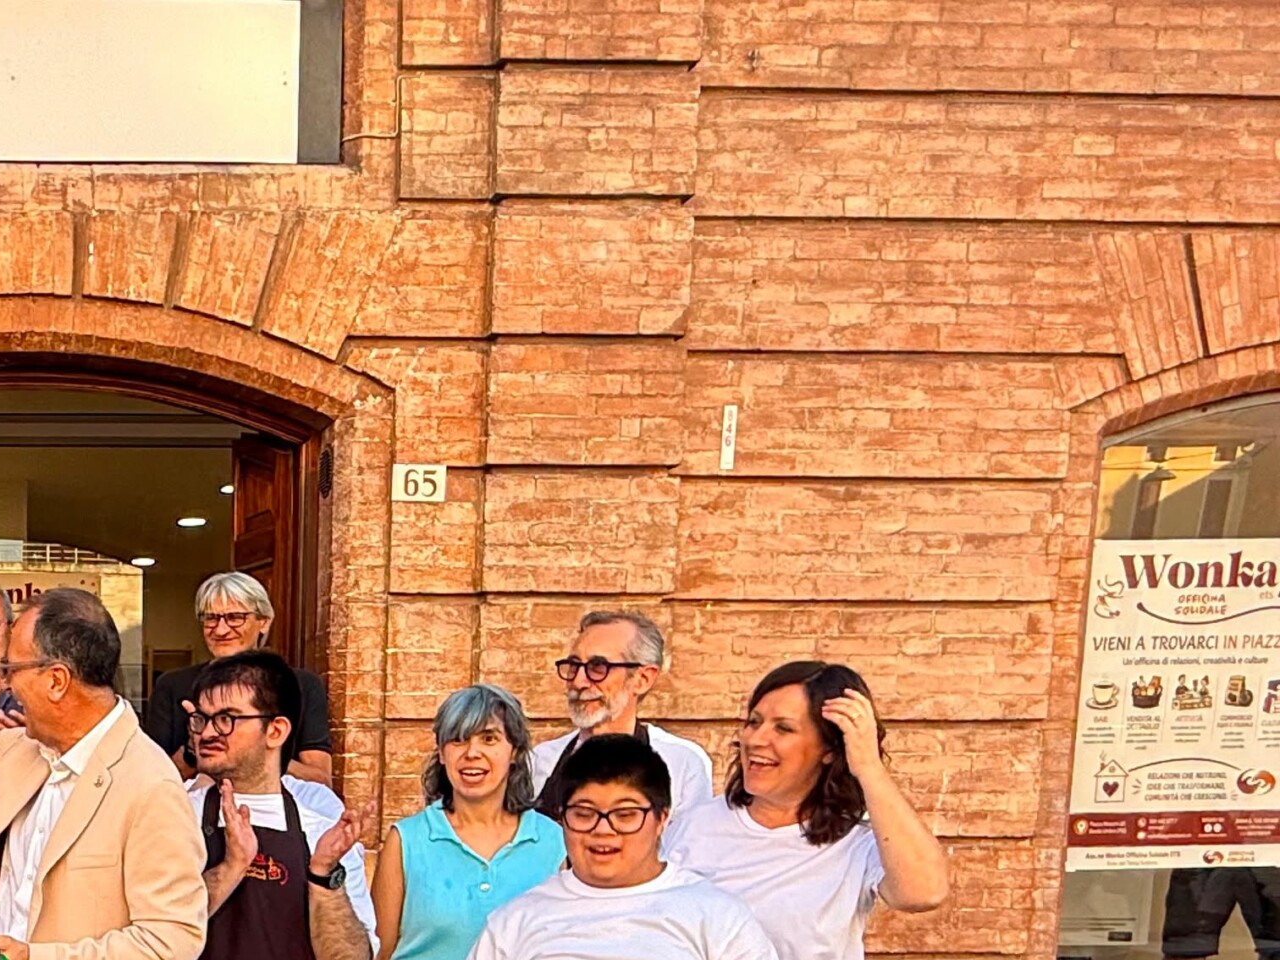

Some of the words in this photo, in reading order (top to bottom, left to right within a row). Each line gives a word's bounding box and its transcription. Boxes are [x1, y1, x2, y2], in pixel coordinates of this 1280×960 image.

[403, 469, 437, 497] 65
[1119, 550, 1279, 589] Wonka
[1178, 593, 1226, 604] OFFICINA
[1174, 605, 1228, 615] SOLIDALE
[1093, 636, 1131, 651] VIENI
[1135, 636, 1145, 650] A
[1151, 635, 1219, 650] TROVARCI
[1223, 635, 1237, 648] IN
